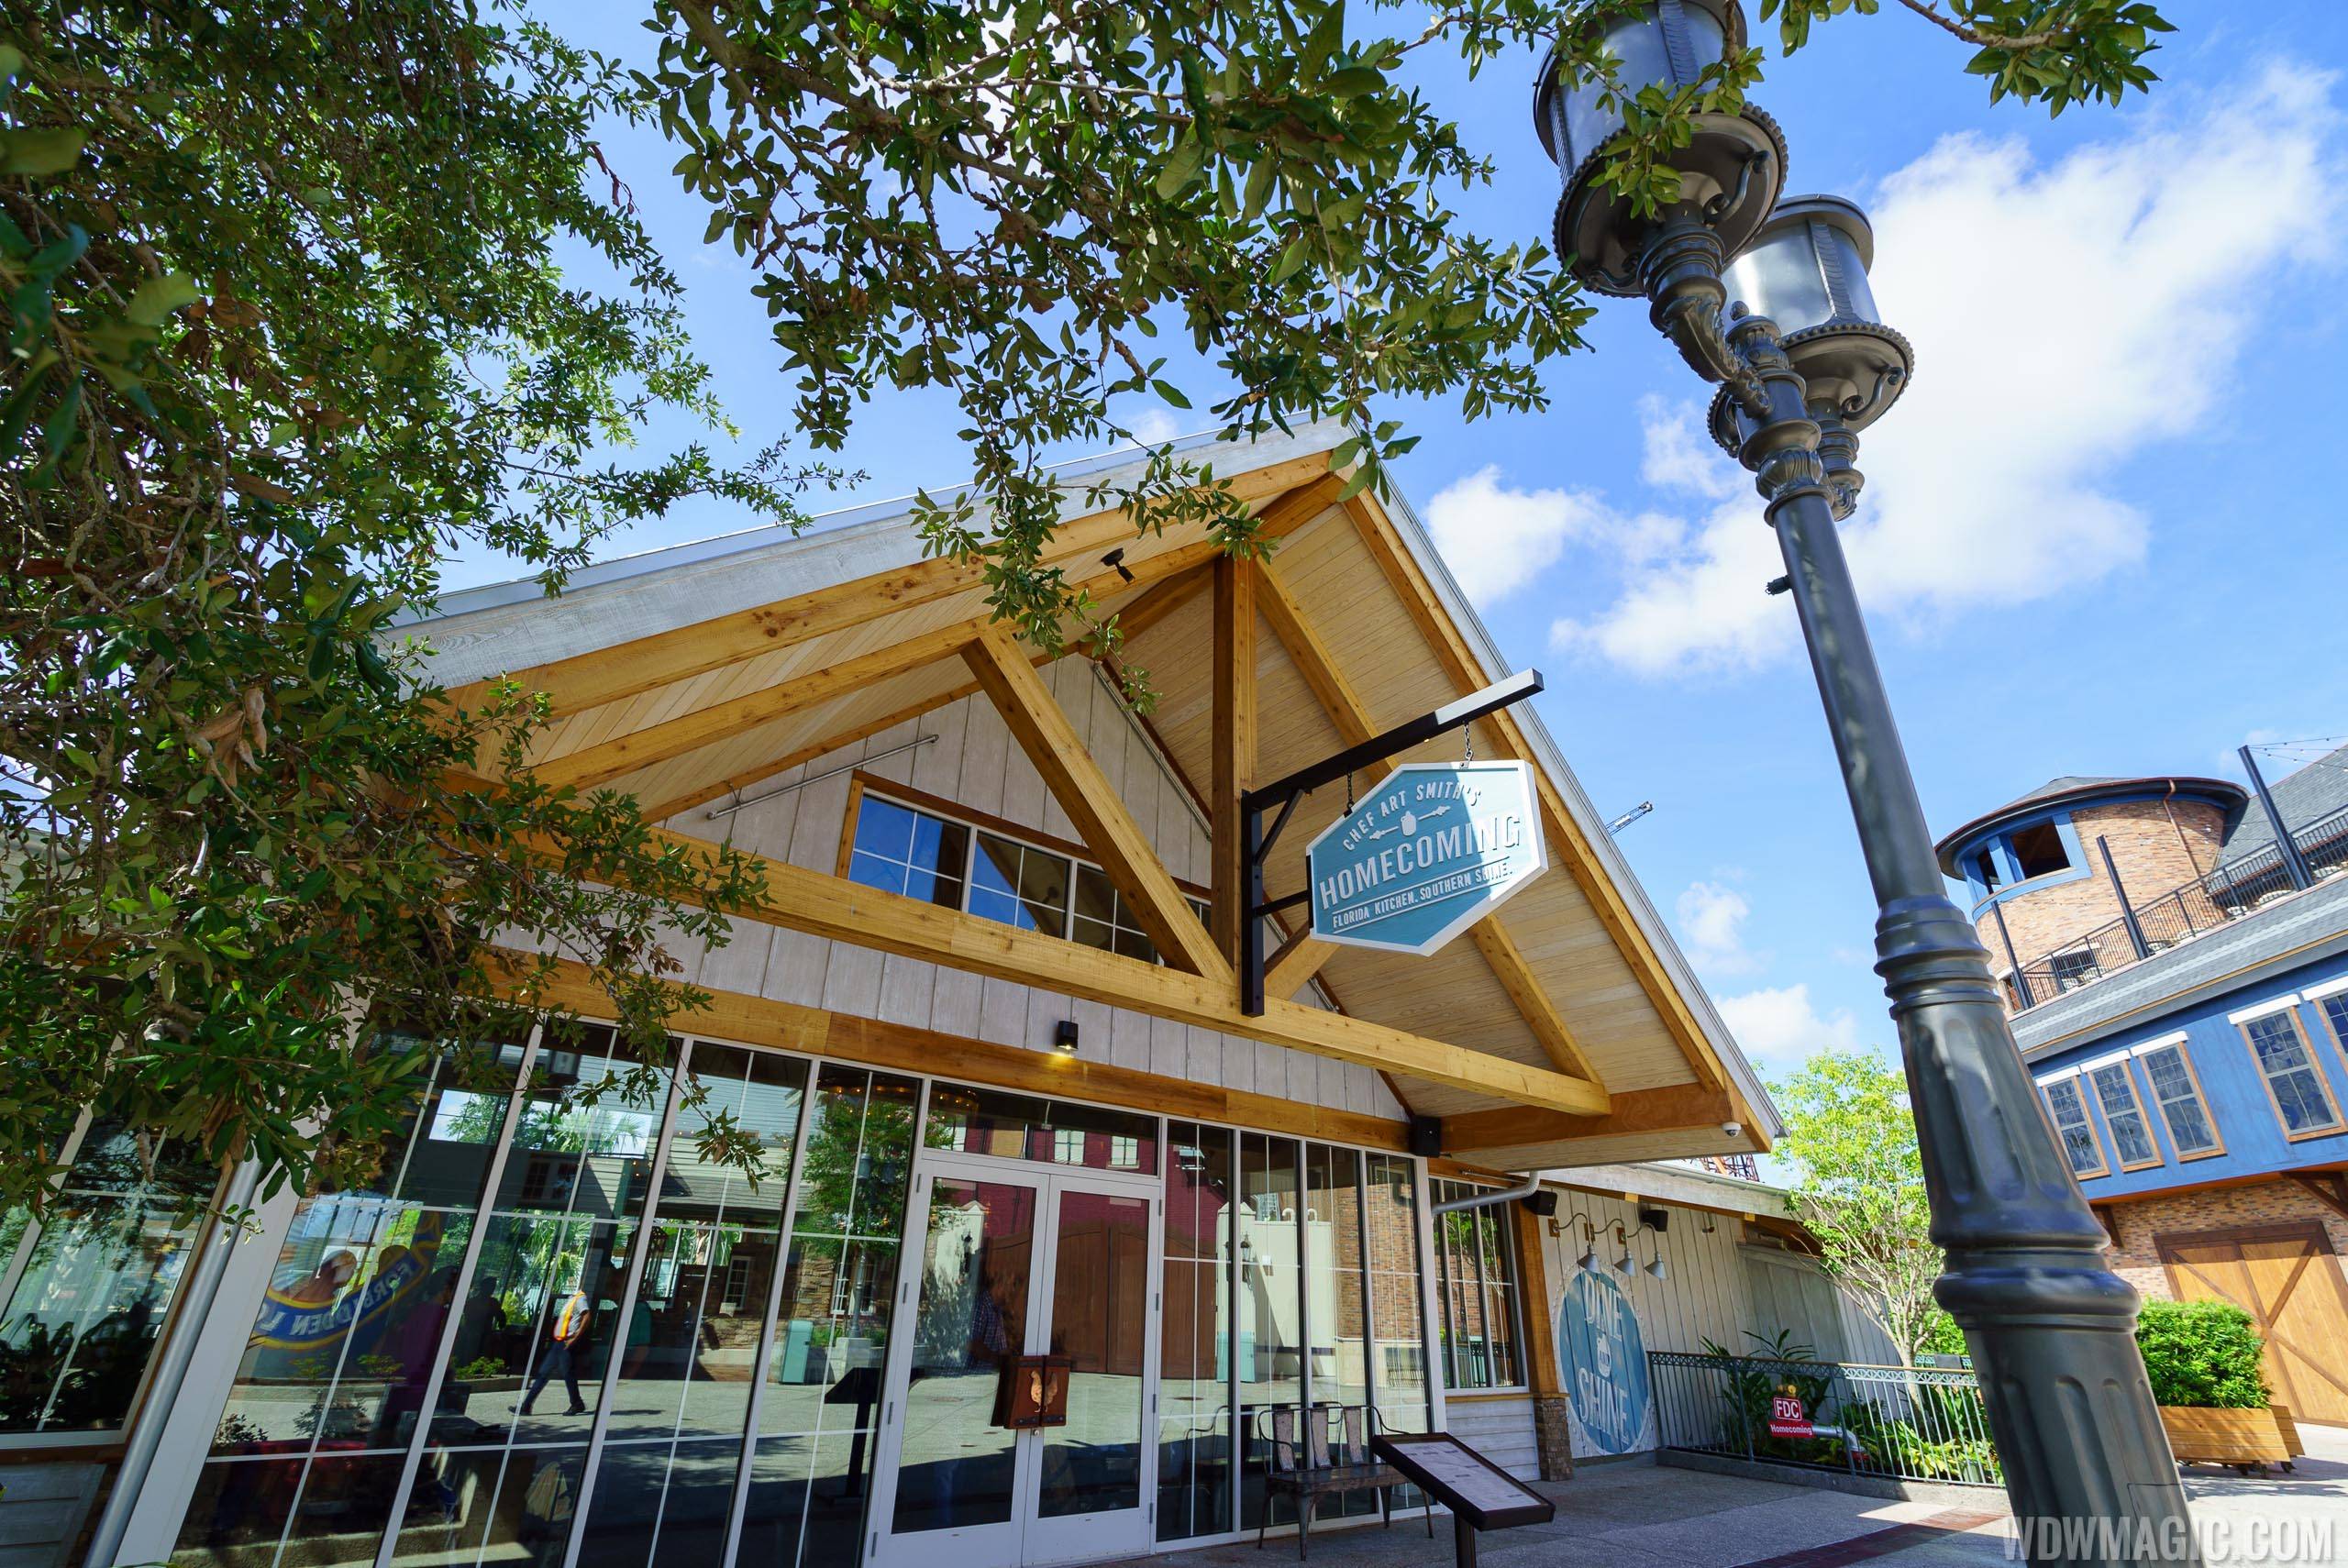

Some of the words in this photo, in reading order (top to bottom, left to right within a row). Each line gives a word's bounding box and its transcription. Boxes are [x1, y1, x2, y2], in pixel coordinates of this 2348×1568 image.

[1343, 811, 1380, 851] CHEF
[1380, 790, 1407, 818] ART
[1416, 781, 1481, 807] SMITH'S
[1319, 814, 1521, 911] HOMECOMING
[1333, 905, 1369, 928] FLORIDA
[1375, 889, 1418, 915] KITCHEN.
[1420, 872, 1472, 900] SOUTHERN
[1584, 1273, 1623, 1342] DINE
[1578, 1367, 1630, 1445] SHINE
[1770, 1424, 1812, 1436] Homecoming
[1775, 1399, 1800, 1419] FDC
